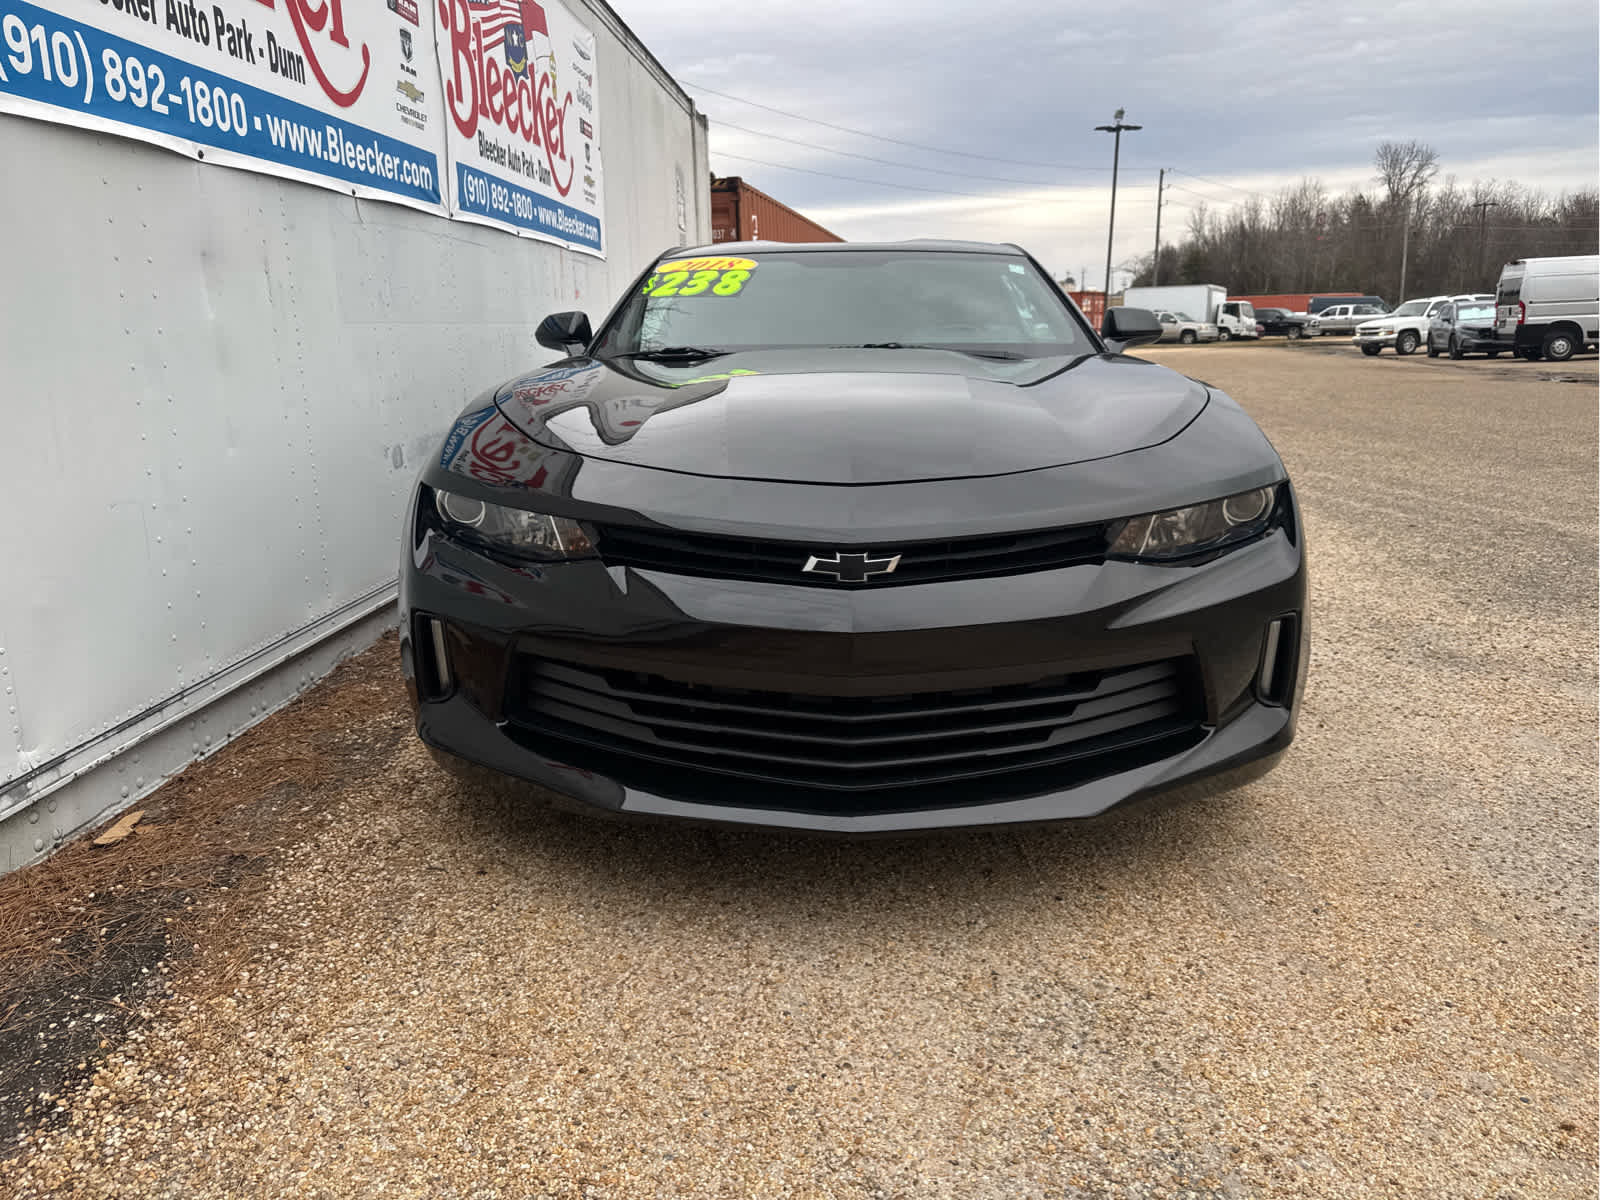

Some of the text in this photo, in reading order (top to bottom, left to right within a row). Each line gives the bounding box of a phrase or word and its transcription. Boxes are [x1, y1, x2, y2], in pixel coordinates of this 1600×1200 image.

[166, 0, 210, 46] Auto
[213, 5, 256, 65] Park
[266, 29, 306, 85] Dunn
[400, 62, 417, 77] RAM
[102, 48, 248, 137] 892-1800
[265, 113, 433, 191] www.Bleecker.com
[395, 102, 428, 122] CHEVROLET
[438, 0, 574, 197] Bleecker
[478, 129, 506, 168] Bleecker
[508, 144, 521, 174] Auto
[522, 151, 535, 180] Park
[538, 159, 552, 187] Dunn
[463, 169, 599, 242] (910) 892-1800 www.Bleecker.com
[641, 270, 752, 297] $238
